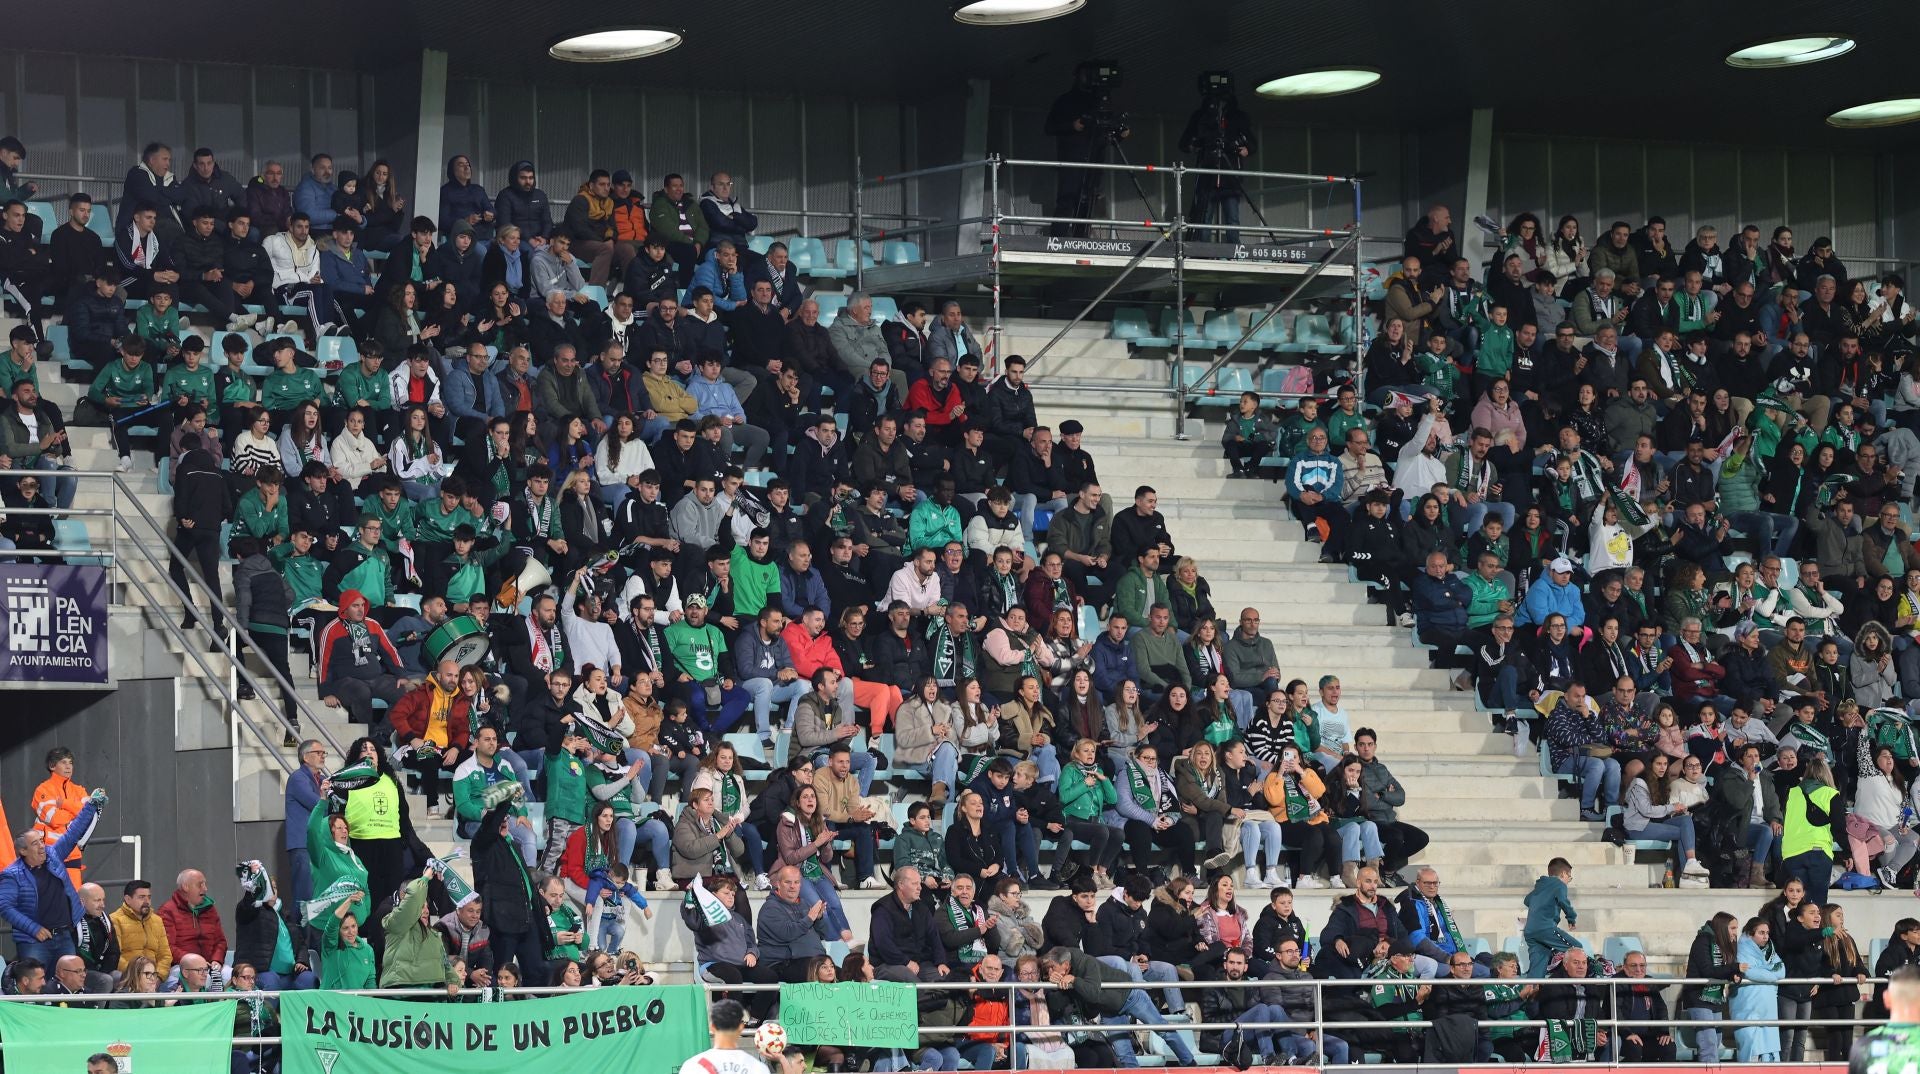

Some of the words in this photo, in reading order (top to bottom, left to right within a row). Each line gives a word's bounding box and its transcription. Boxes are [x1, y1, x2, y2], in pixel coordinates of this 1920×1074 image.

[1063, 240, 1131, 252] AYGPRODSERVICES
[1252, 248, 1268, 257] 605
[1271, 249, 1288, 258] 855
[1290, 250, 1306, 259] 565
[56, 597, 80, 615] PA
[56, 616, 92, 634] LEN
[55, 635, 87, 653] CIA
[10, 655, 92, 667] AYUNTAMIENTO
[306, 1005, 342, 1038] LA
[465, 1022, 498, 1051] DE
[512, 1020, 551, 1051] UN
[562, 998, 665, 1044] PUEBLO
